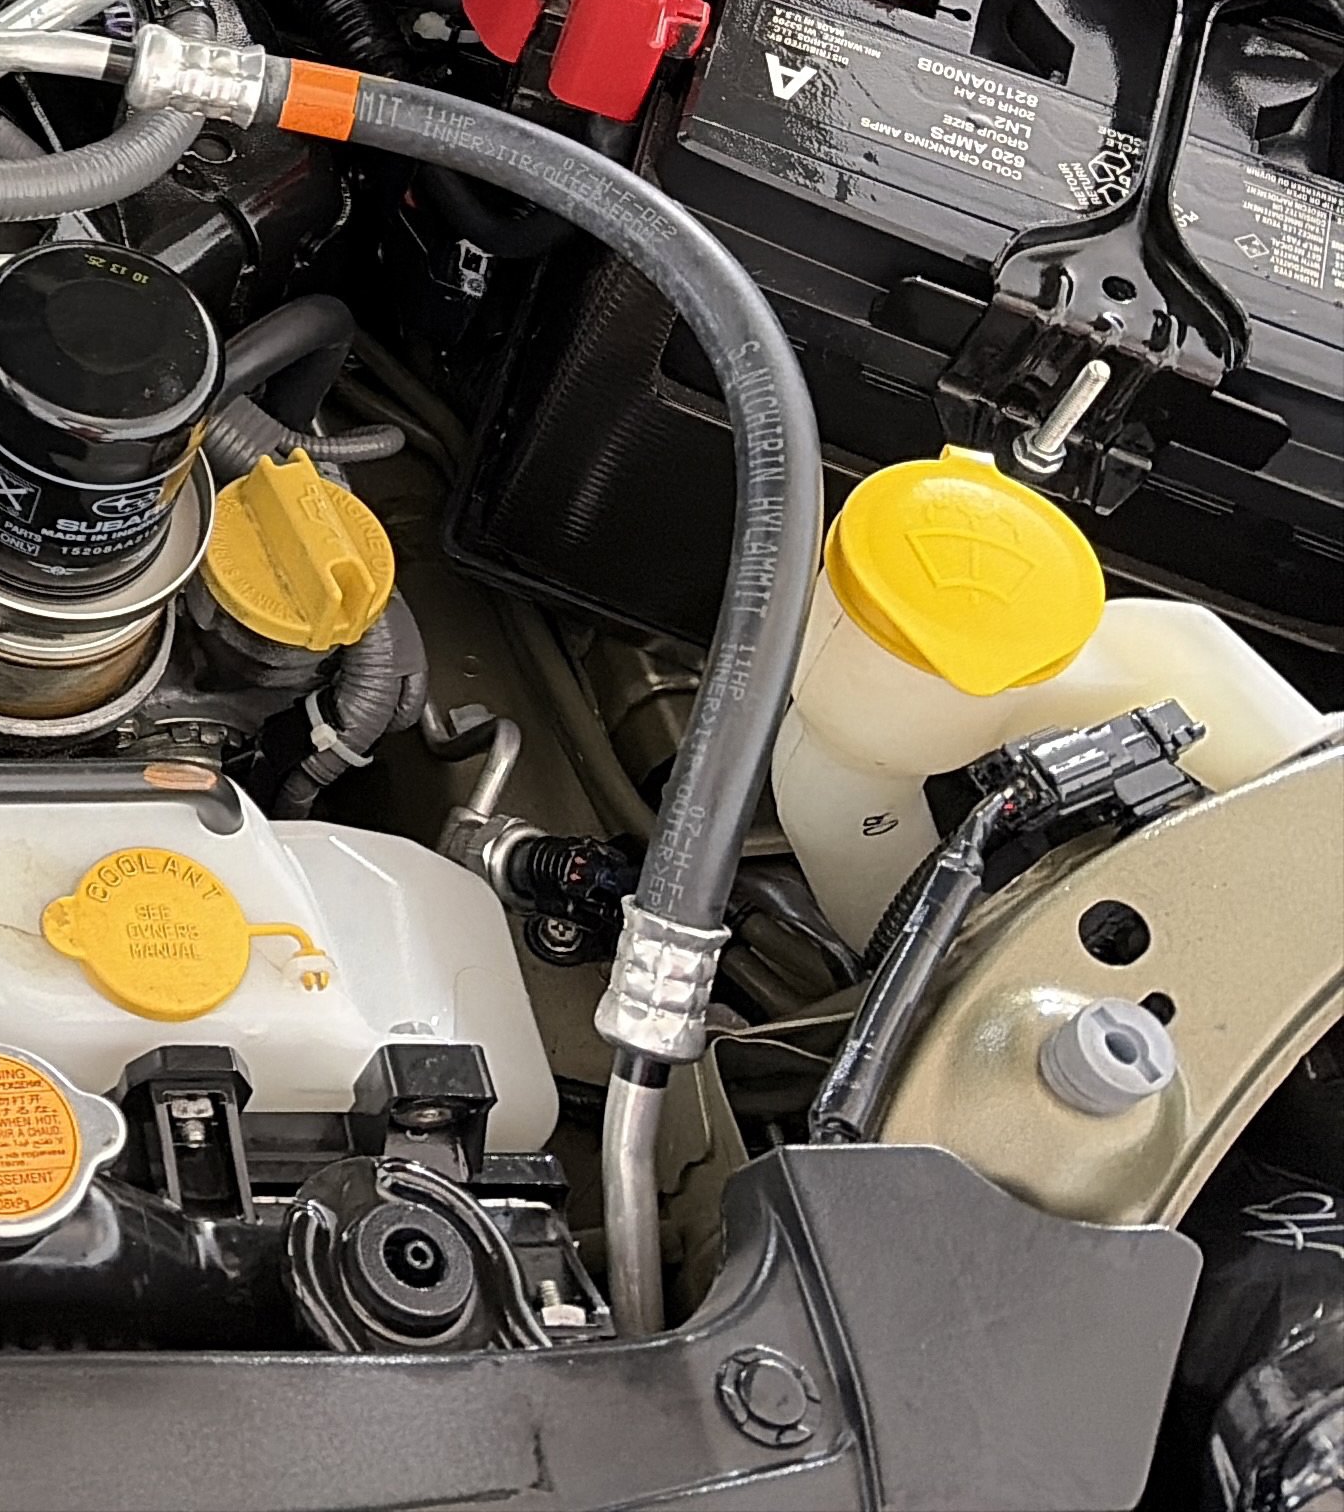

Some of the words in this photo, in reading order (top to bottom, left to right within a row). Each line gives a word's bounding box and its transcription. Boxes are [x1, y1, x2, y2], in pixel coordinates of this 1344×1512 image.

[803, 17, 814, 26] IN
[804, 25, 817, 36] WI
[816, 21, 845, 36] MADE
[783, 37, 849, 64] DISTRIBUTED
[765, 52, 817, 100] A
[916, 56, 1039, 107] 82110AN00B
[953, 85, 975, 100] AH
[997, 100, 1035, 120] 20HR
[859, 116, 901, 138] AMPS
[942, 114, 975, 133] SIZE
[992, 115, 1032, 138] LN2
[928, 125, 988, 155] AMPS
[976, 125, 1029, 151] GROUP
[1105, 138, 1140, 155] YCLE
[903, 131, 980, 166] CRANKING
[990, 146, 1026, 167] 620
[981, 159, 1023, 181] COLD
[1245, 166, 1277, 182] OUVRIR
[1058, 162, 1088, 206] RETOUR
[1071, 163, 1101, 204] RETURN
[1277, 178, 1289, 187] OU
[1309, 196, 1321, 205] OR
[1322, 200, 1334, 210] TIP
[1302, 240, 1323, 253] HELP
[1307, 250, 1322, 261] GET
[1272, 265, 1292, 278] EYES
[1300, 257, 1321, 270] WITH
[1293, 273, 1318, 286] FLUSH
[329, 487, 385, 555] NGINE
[3, 520, 43, 543] PARTS
[41, 528, 86, 542] MADE
[0, 532, 35, 553] ONLY
[729, 644, 756, 701] 11HP
[665, 807, 706, 921] 07-H-F-
[86, 853, 224, 902] COOLANT
[135, 904, 172, 920] SEE
[126, 923, 201, 939] OWNERS
[129, 943, 204, 959] MANUAL
